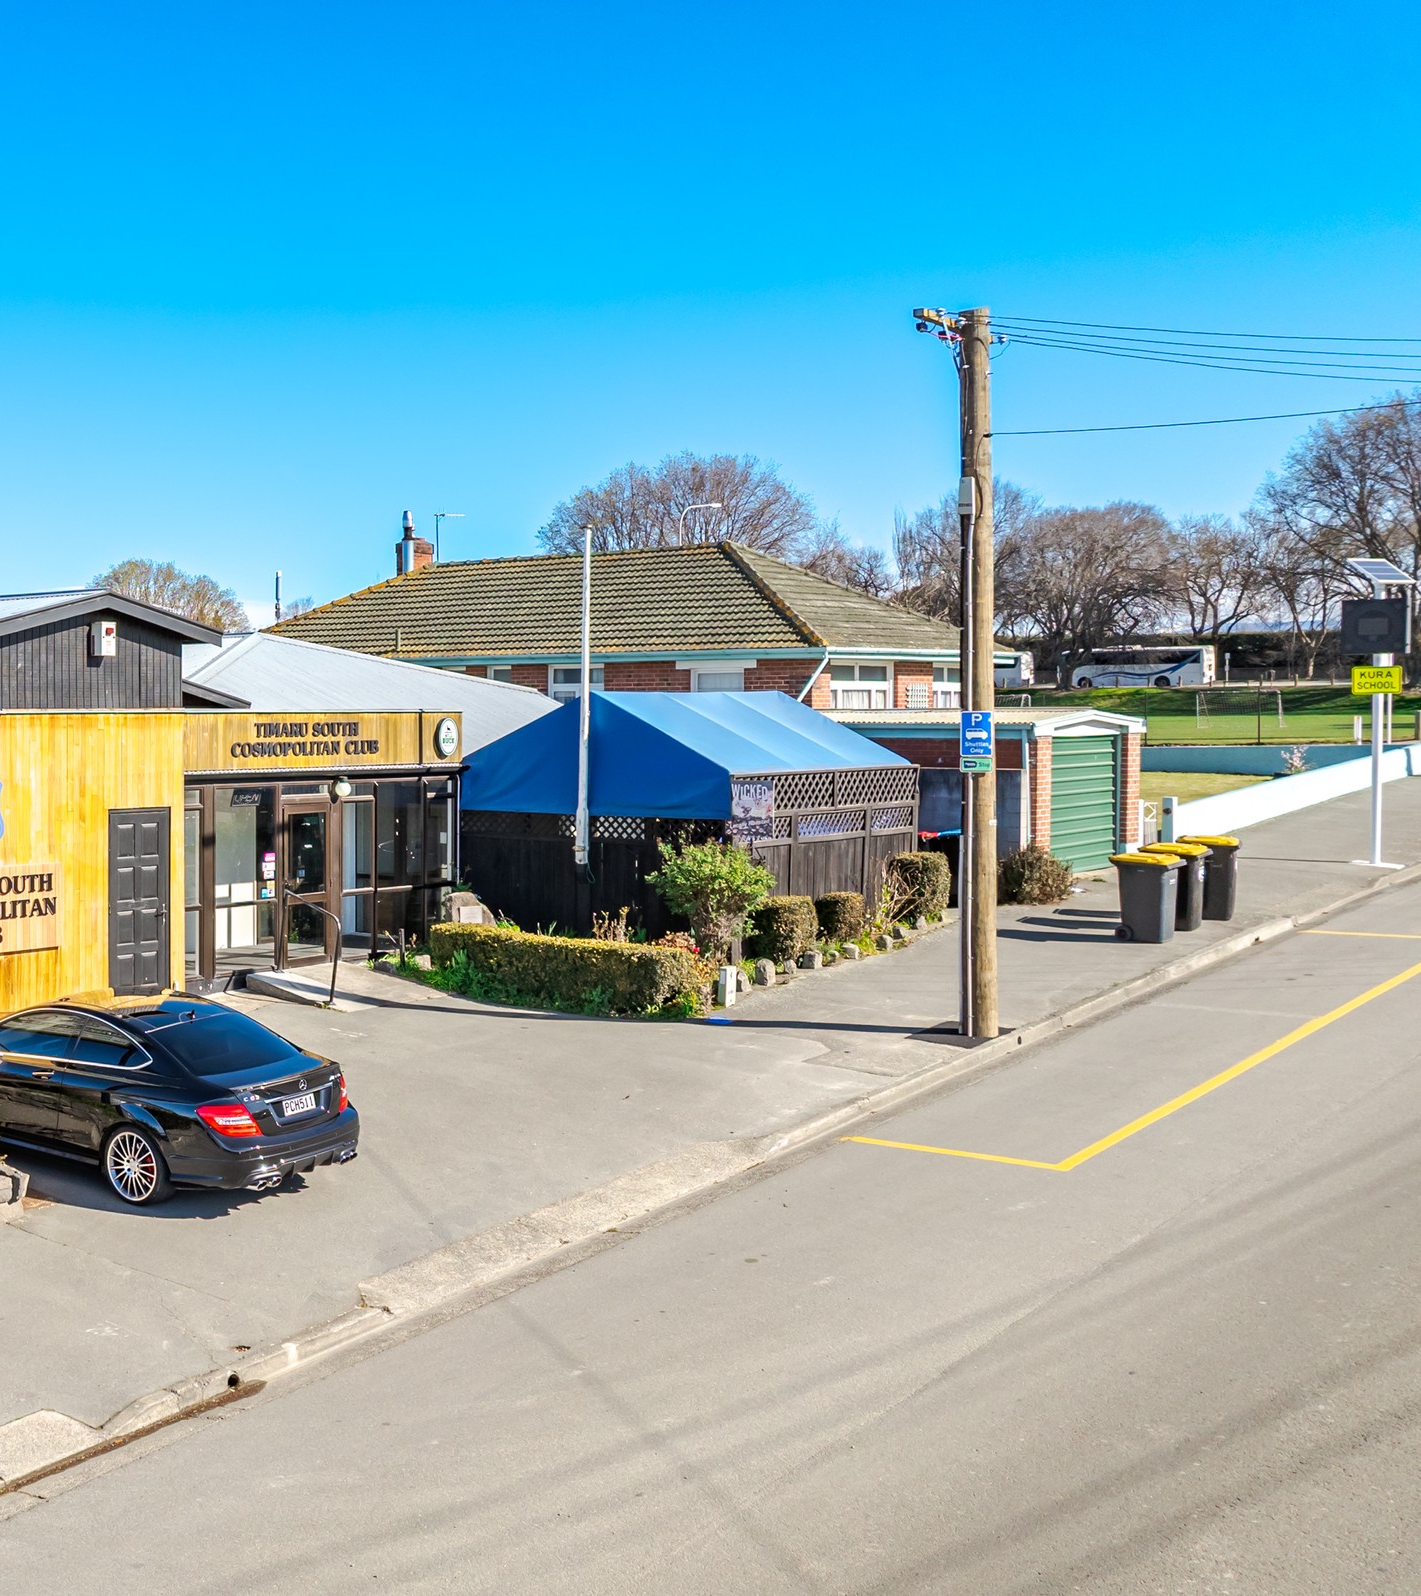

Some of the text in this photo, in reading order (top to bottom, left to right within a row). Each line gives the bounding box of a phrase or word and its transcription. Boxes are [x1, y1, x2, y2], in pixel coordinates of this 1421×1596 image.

[1360, 671, 1393, 679] KURA
[1357, 681, 1397, 690] SCHOOL
[971, 713, 983, 726] P
[254, 721, 359, 738] TIMARU SOUTH
[230, 740, 379, 758] COSMOPOLITAN CLUB
[731, 783, 768, 801] WICKED
[284, 1095, 314, 1113] PCH511
